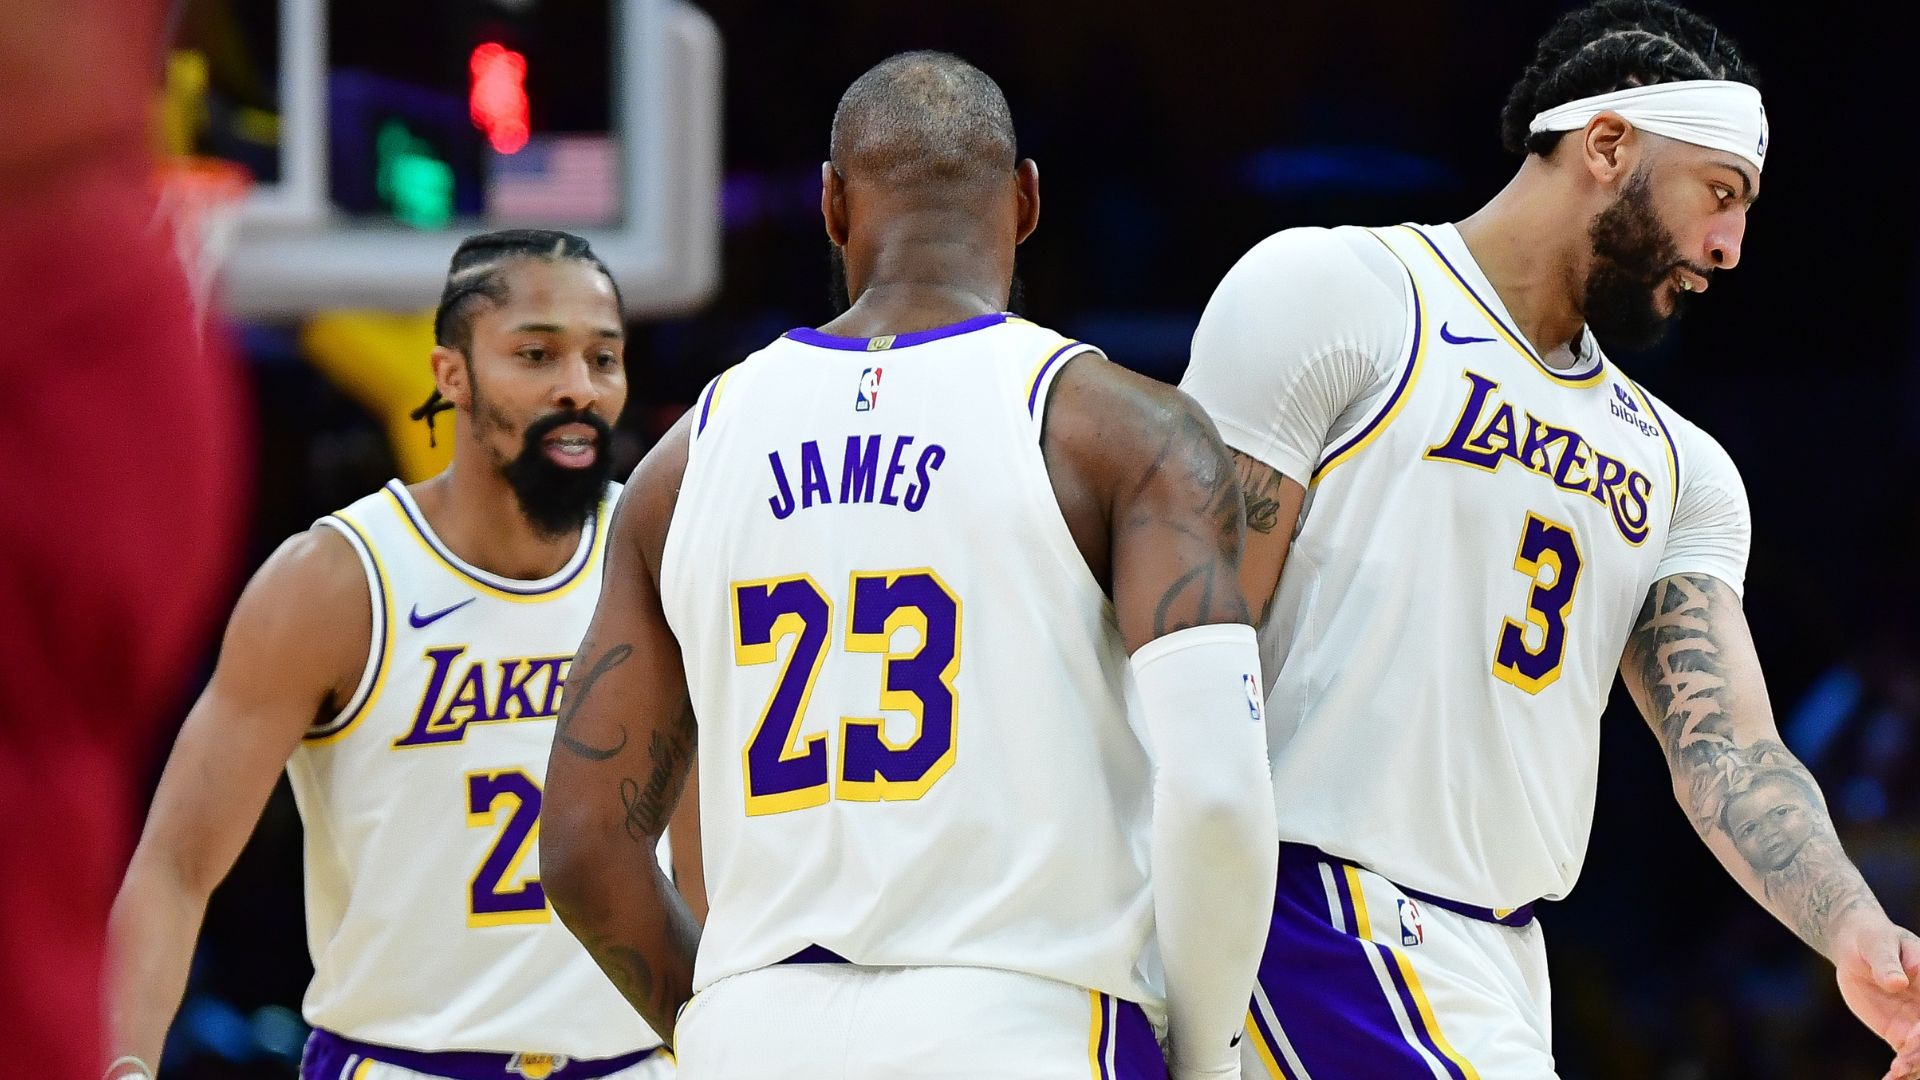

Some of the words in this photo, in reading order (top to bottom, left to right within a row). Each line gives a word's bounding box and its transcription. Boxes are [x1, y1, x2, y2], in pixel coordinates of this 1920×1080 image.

[768, 434, 946, 520] JAMES
[1422, 367, 1655, 548] LAKERS
[1609, 398, 1660, 437] bibigo
[1492, 510, 1584, 696] 3
[389, 643, 576, 751] LAKE
[730, 566, 963, 818] 23
[464, 765, 551, 929] 2
